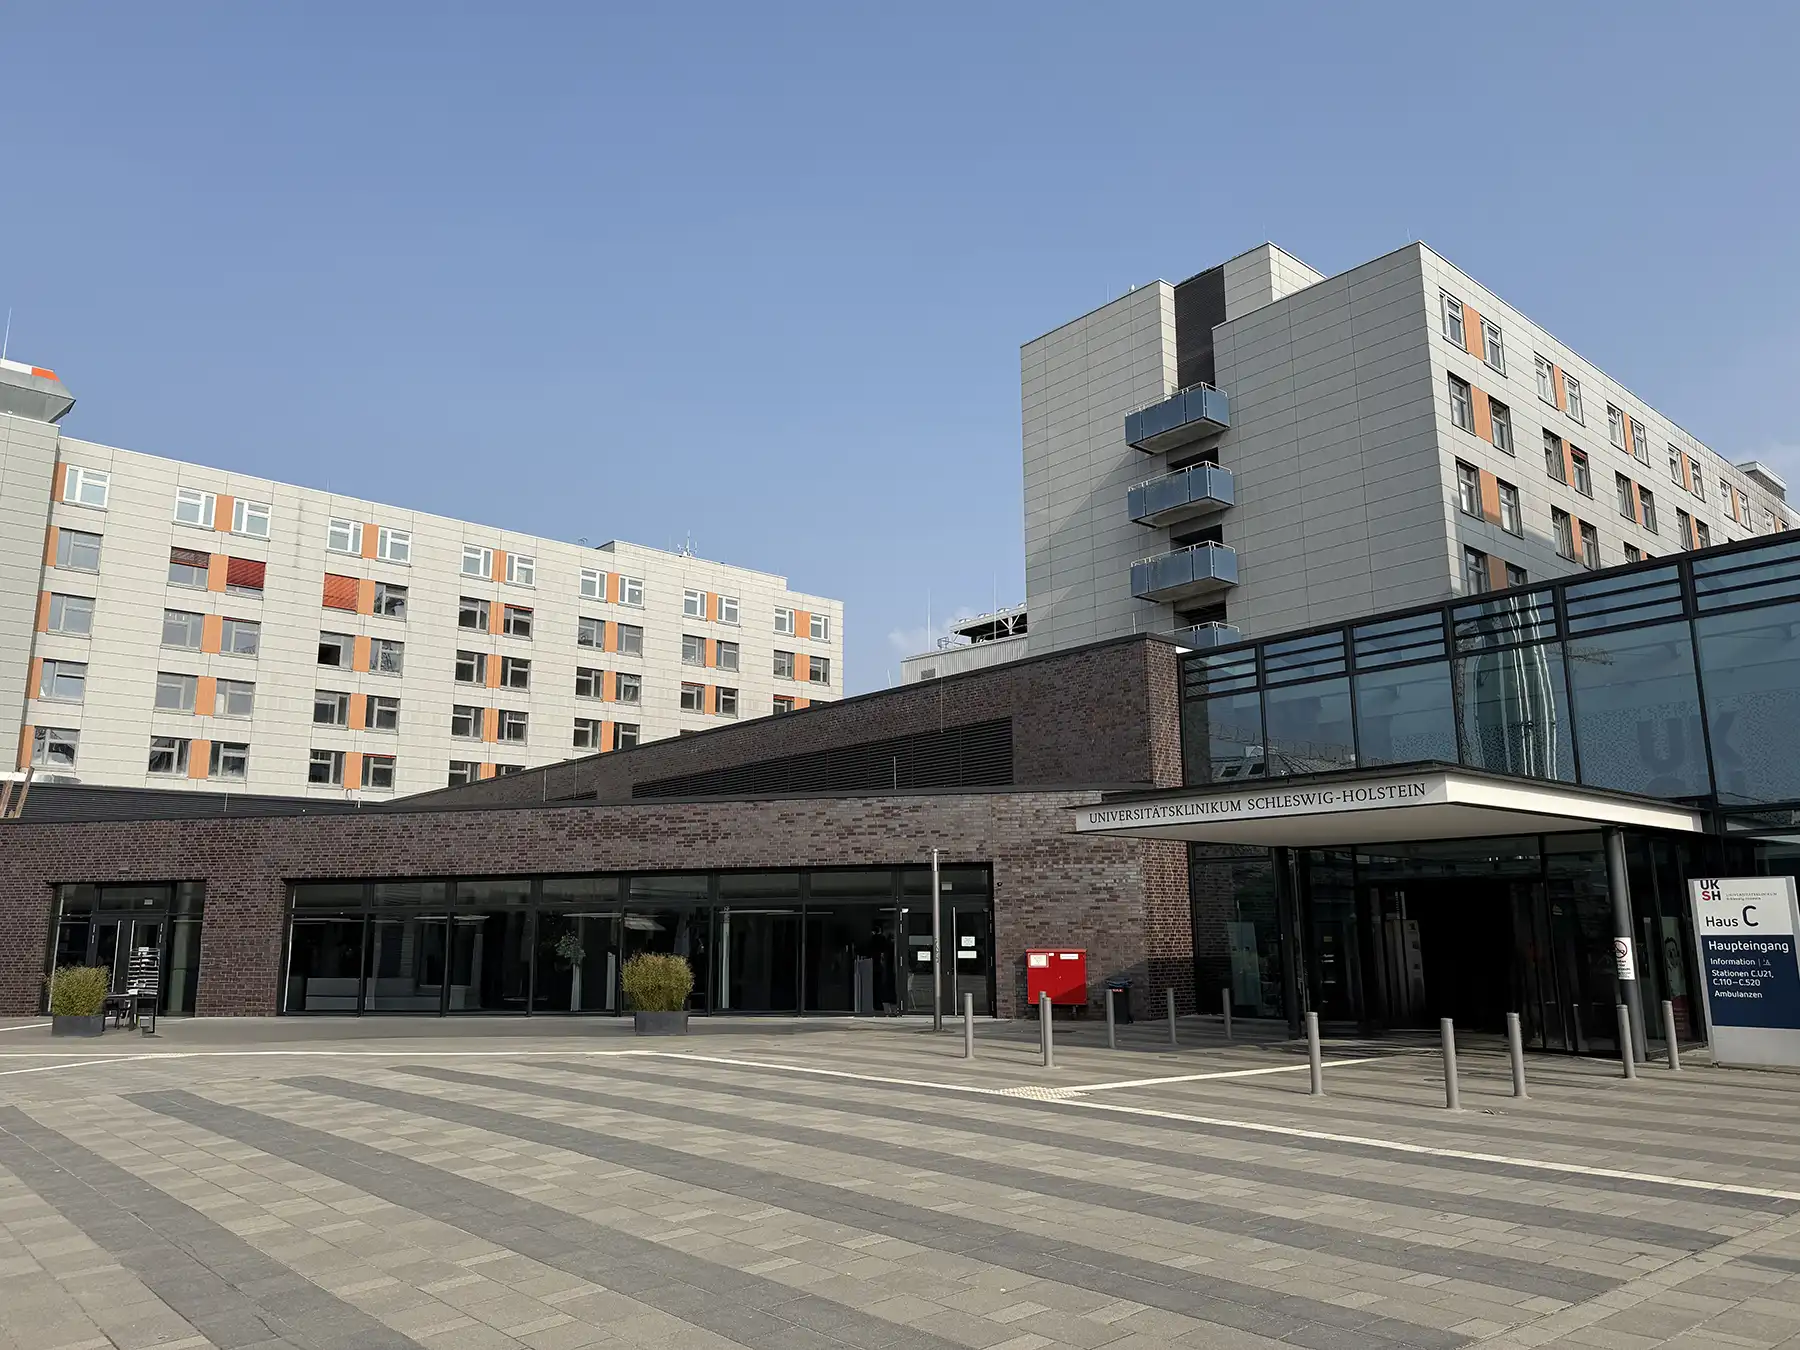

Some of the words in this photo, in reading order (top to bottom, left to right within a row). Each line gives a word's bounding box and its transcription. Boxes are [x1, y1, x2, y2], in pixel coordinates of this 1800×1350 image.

[1088, 799, 1242, 824] UNIVERSITÄTSKLINIKUM
[1247, 782, 1427, 811] SCHLESWIG-HOLSTEIN
[1705, 916, 1739, 927] Haus
[1742, 905, 1759, 927] C
[1708, 940, 1789, 953] Haupteingang
[1710, 957, 1756, 966] Information
[1711, 969, 1749, 977] Stationen
[1714, 990, 1763, 999] Ambulanzen
